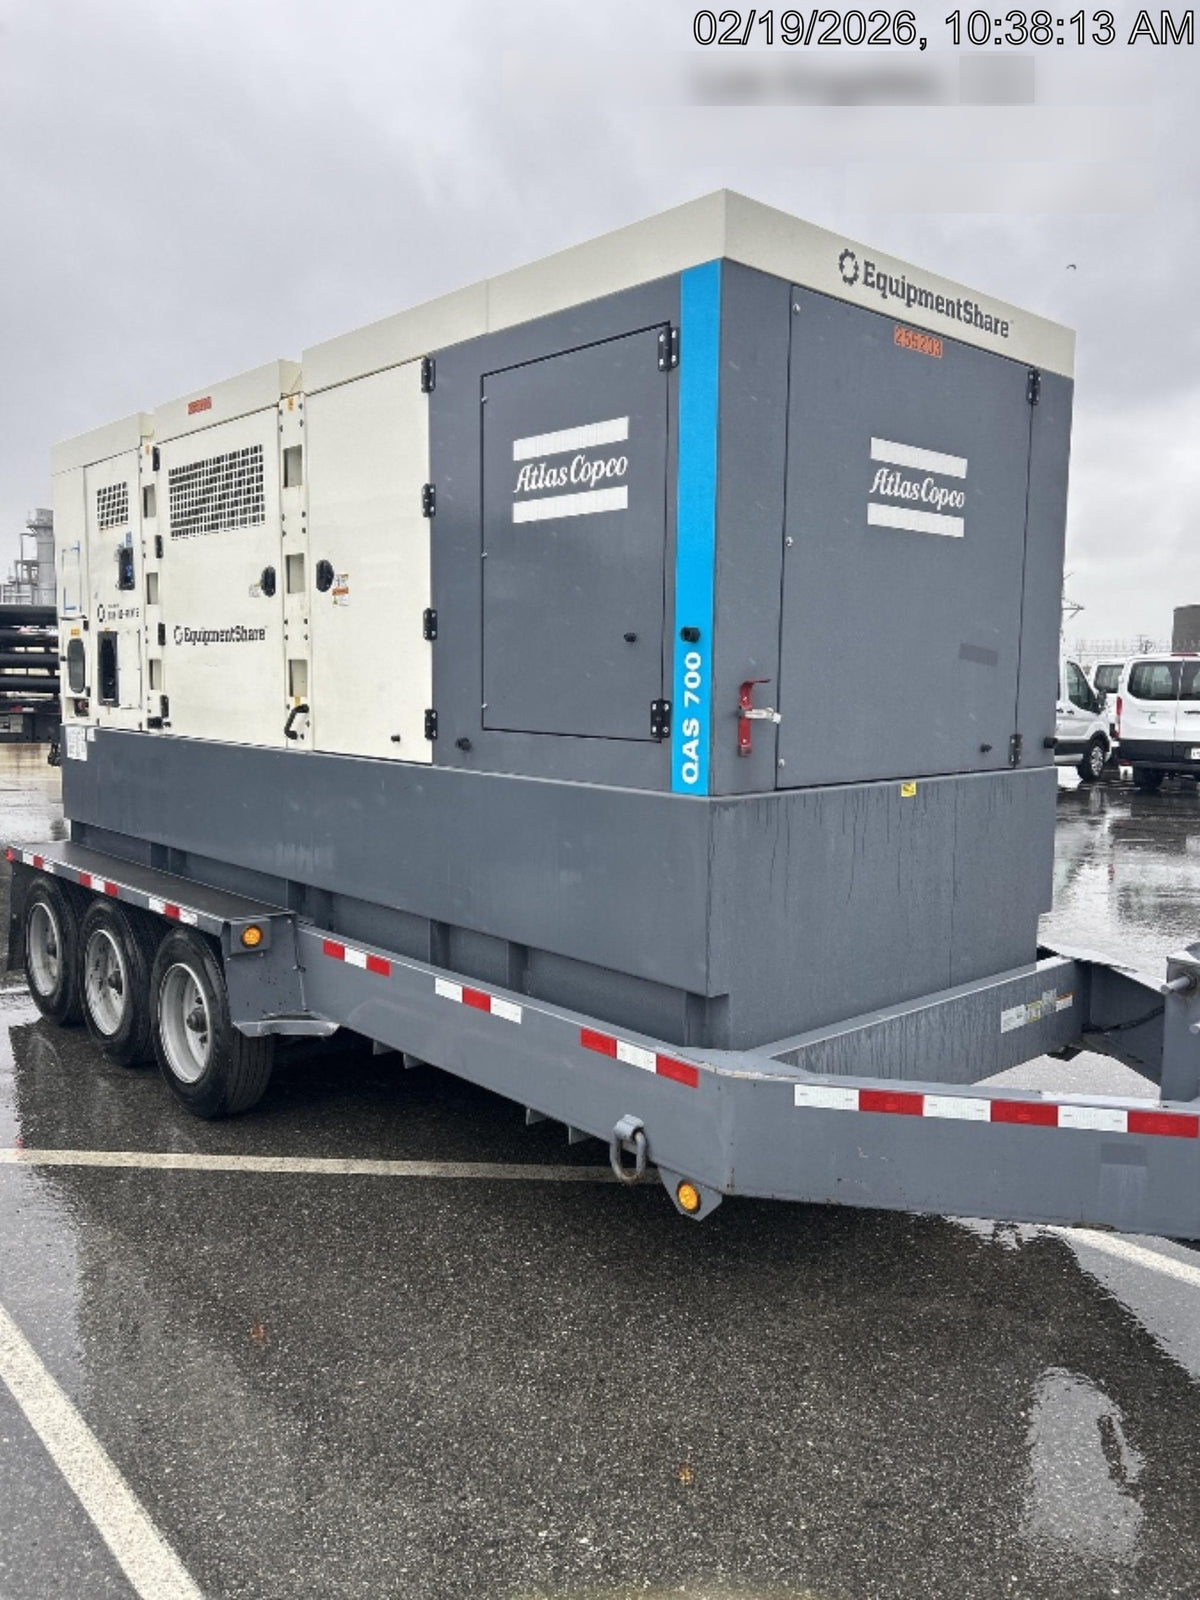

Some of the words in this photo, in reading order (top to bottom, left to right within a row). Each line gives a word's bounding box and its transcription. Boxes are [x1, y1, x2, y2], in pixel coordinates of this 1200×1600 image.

[863, 259, 1009, 338] EquipmentShare
[184, 625, 266, 646] EquipmentShare
[684, 651, 702, 708] 700
[682, 717, 700, 785] QAS
